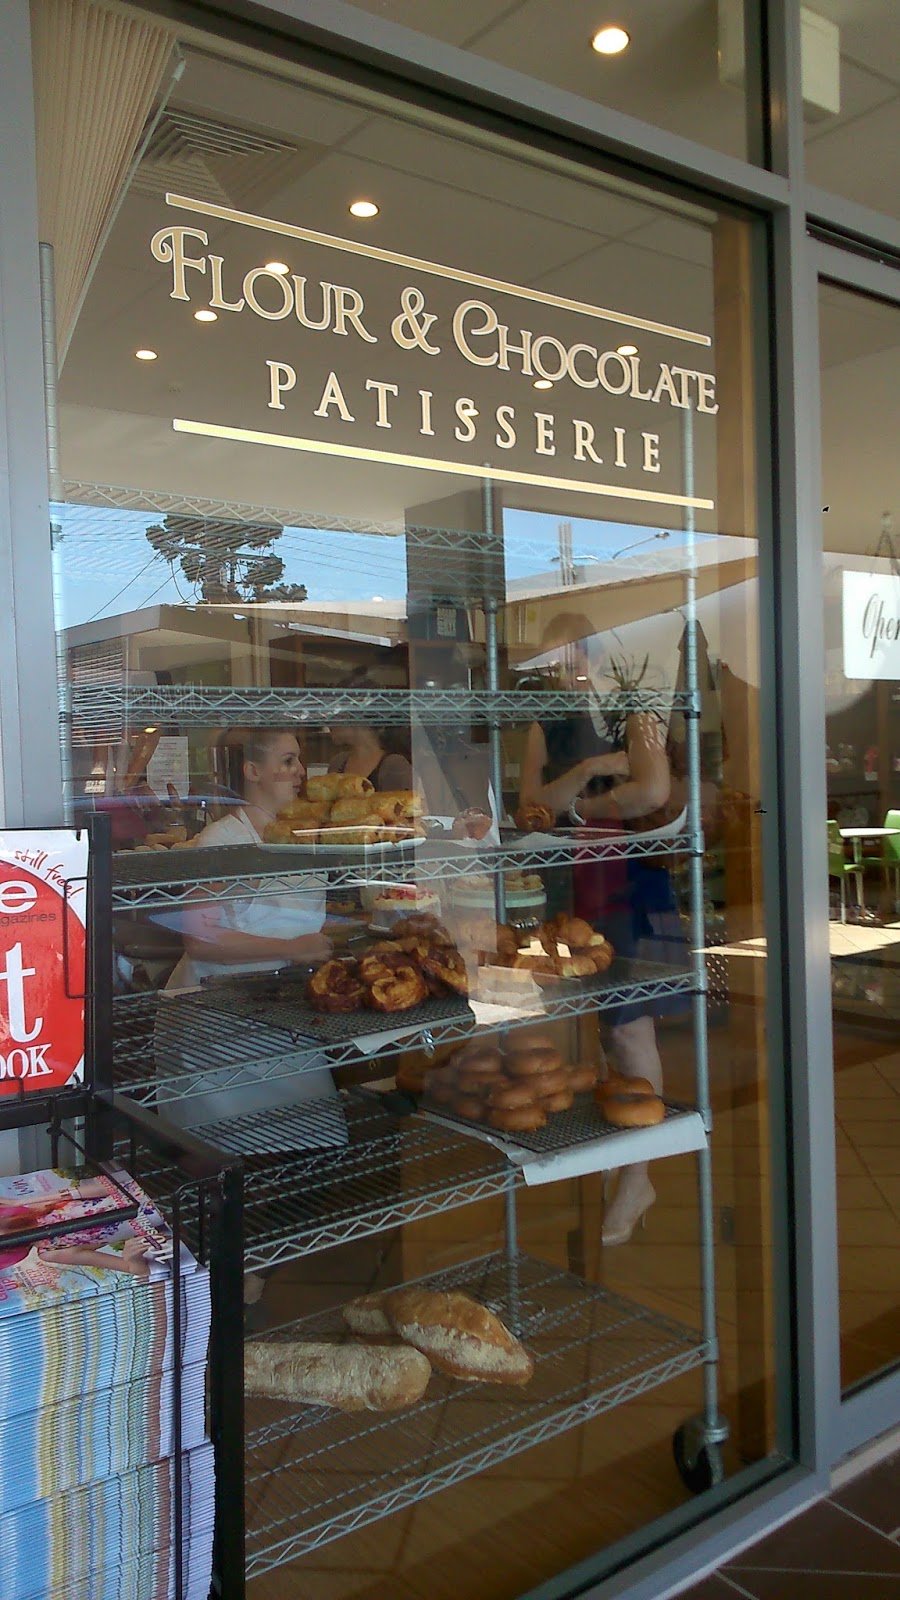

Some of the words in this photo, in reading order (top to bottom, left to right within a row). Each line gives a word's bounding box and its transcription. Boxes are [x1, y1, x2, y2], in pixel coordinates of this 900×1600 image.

[150, 226, 378, 343] FLOUR
[391, 286, 441, 356] &
[452, 299, 720, 414] CHOCOLATE
[265, 360, 662, 473] PATISSERIE
[15, 849, 48, 870] still
[44, 864, 85, 899] free!
